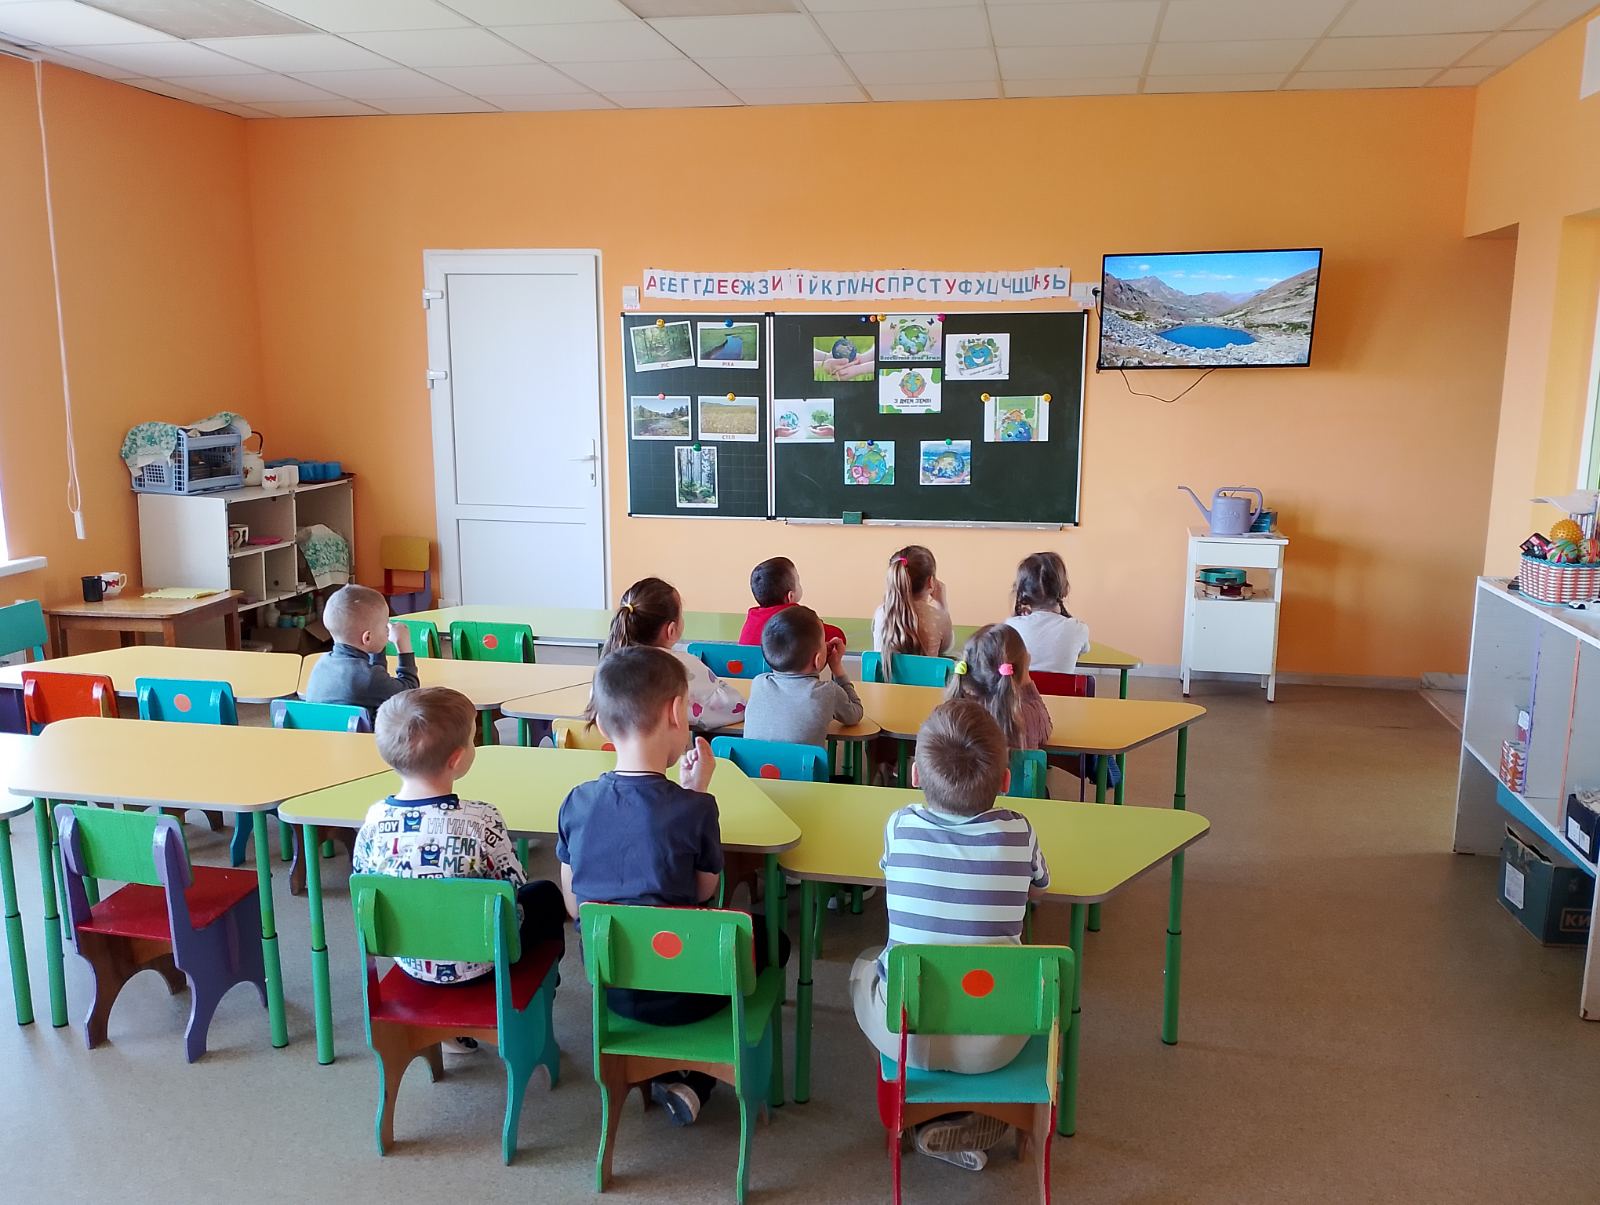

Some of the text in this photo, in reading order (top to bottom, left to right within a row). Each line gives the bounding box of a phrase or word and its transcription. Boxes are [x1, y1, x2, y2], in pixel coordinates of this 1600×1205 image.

[378, 821, 399, 833] BOY
[445, 836, 477, 857] FEAR
[443, 856, 465, 873] ME
